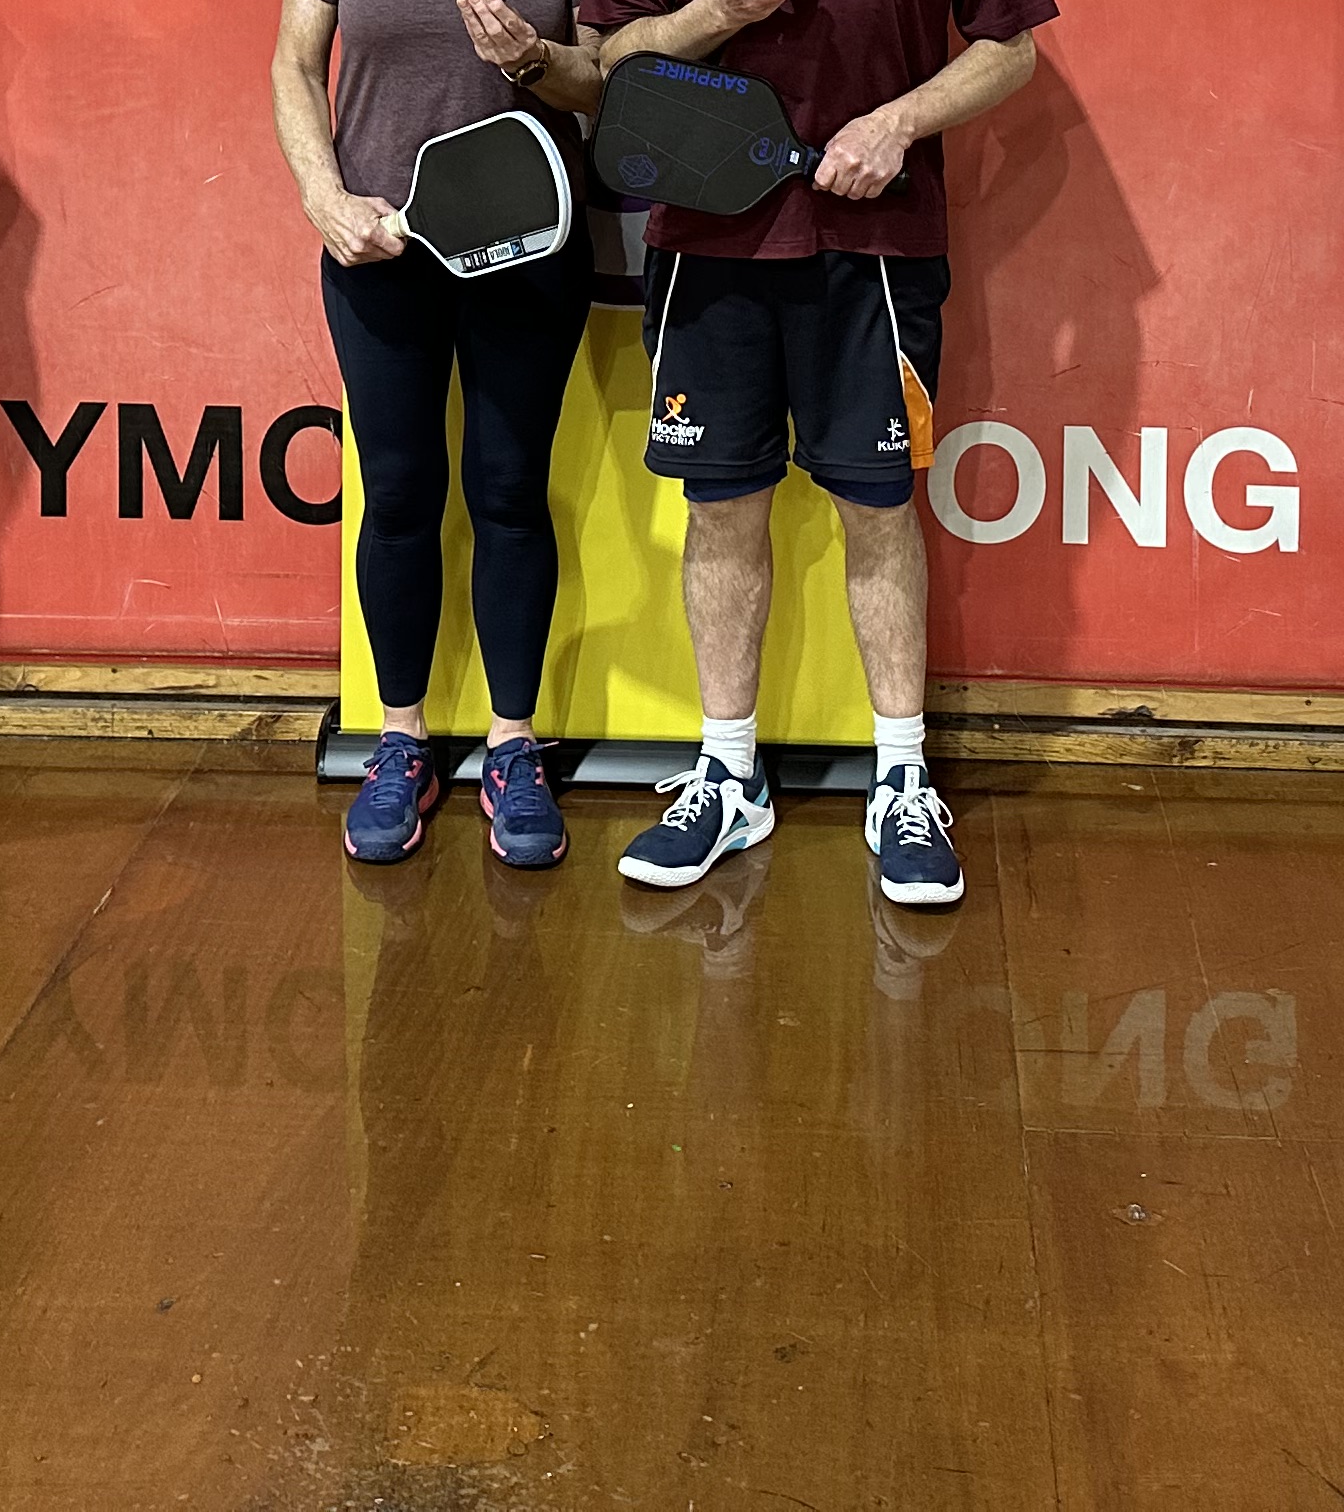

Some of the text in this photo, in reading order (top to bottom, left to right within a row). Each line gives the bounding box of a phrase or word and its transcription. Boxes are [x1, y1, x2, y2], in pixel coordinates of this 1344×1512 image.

[655, 58, 750, 95] SAPPHIRE
[651, 418, 705, 442] Hockey
[877, 439, 911, 452] KUKR
[927, 421, 1301, 554] ONG
